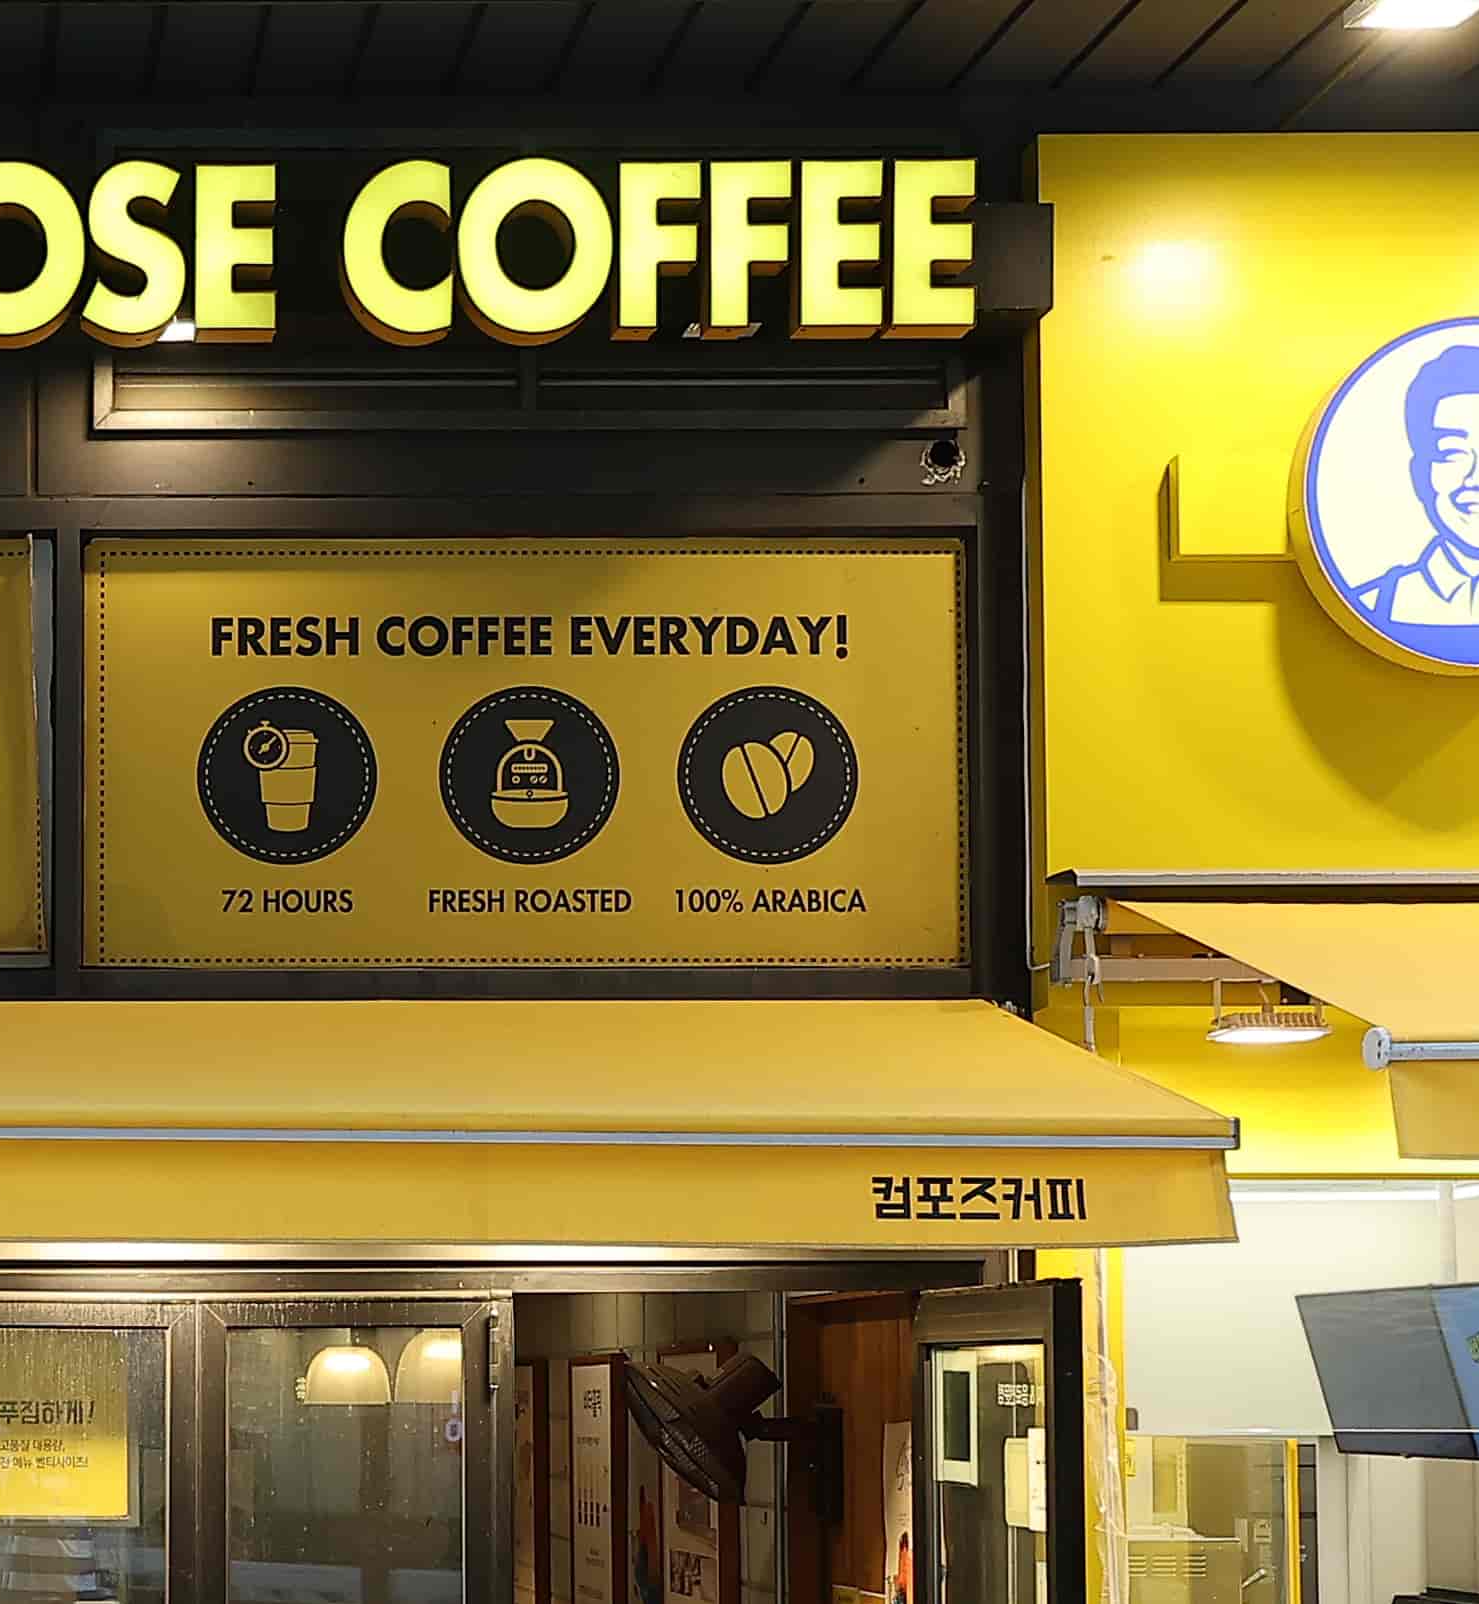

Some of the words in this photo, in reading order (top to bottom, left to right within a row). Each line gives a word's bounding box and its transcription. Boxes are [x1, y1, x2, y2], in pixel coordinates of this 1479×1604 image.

[344, 158, 976, 343] COFFEE
[211, 616, 360, 657] FRESH
[374, 615, 553, 658] COFFEE
[571, 615, 849, 659] EVERYDAY!
[221, 889, 254, 914] 72
[262, 889, 354, 914] HOURS
[427, 889, 509, 914] FRESH
[515, 889, 633, 914] ROASTED
[675, 889, 744, 914] 100%
[751, 889, 867, 914] ARABICA
[872, 1176, 1087, 1220] 컴포즈커피
